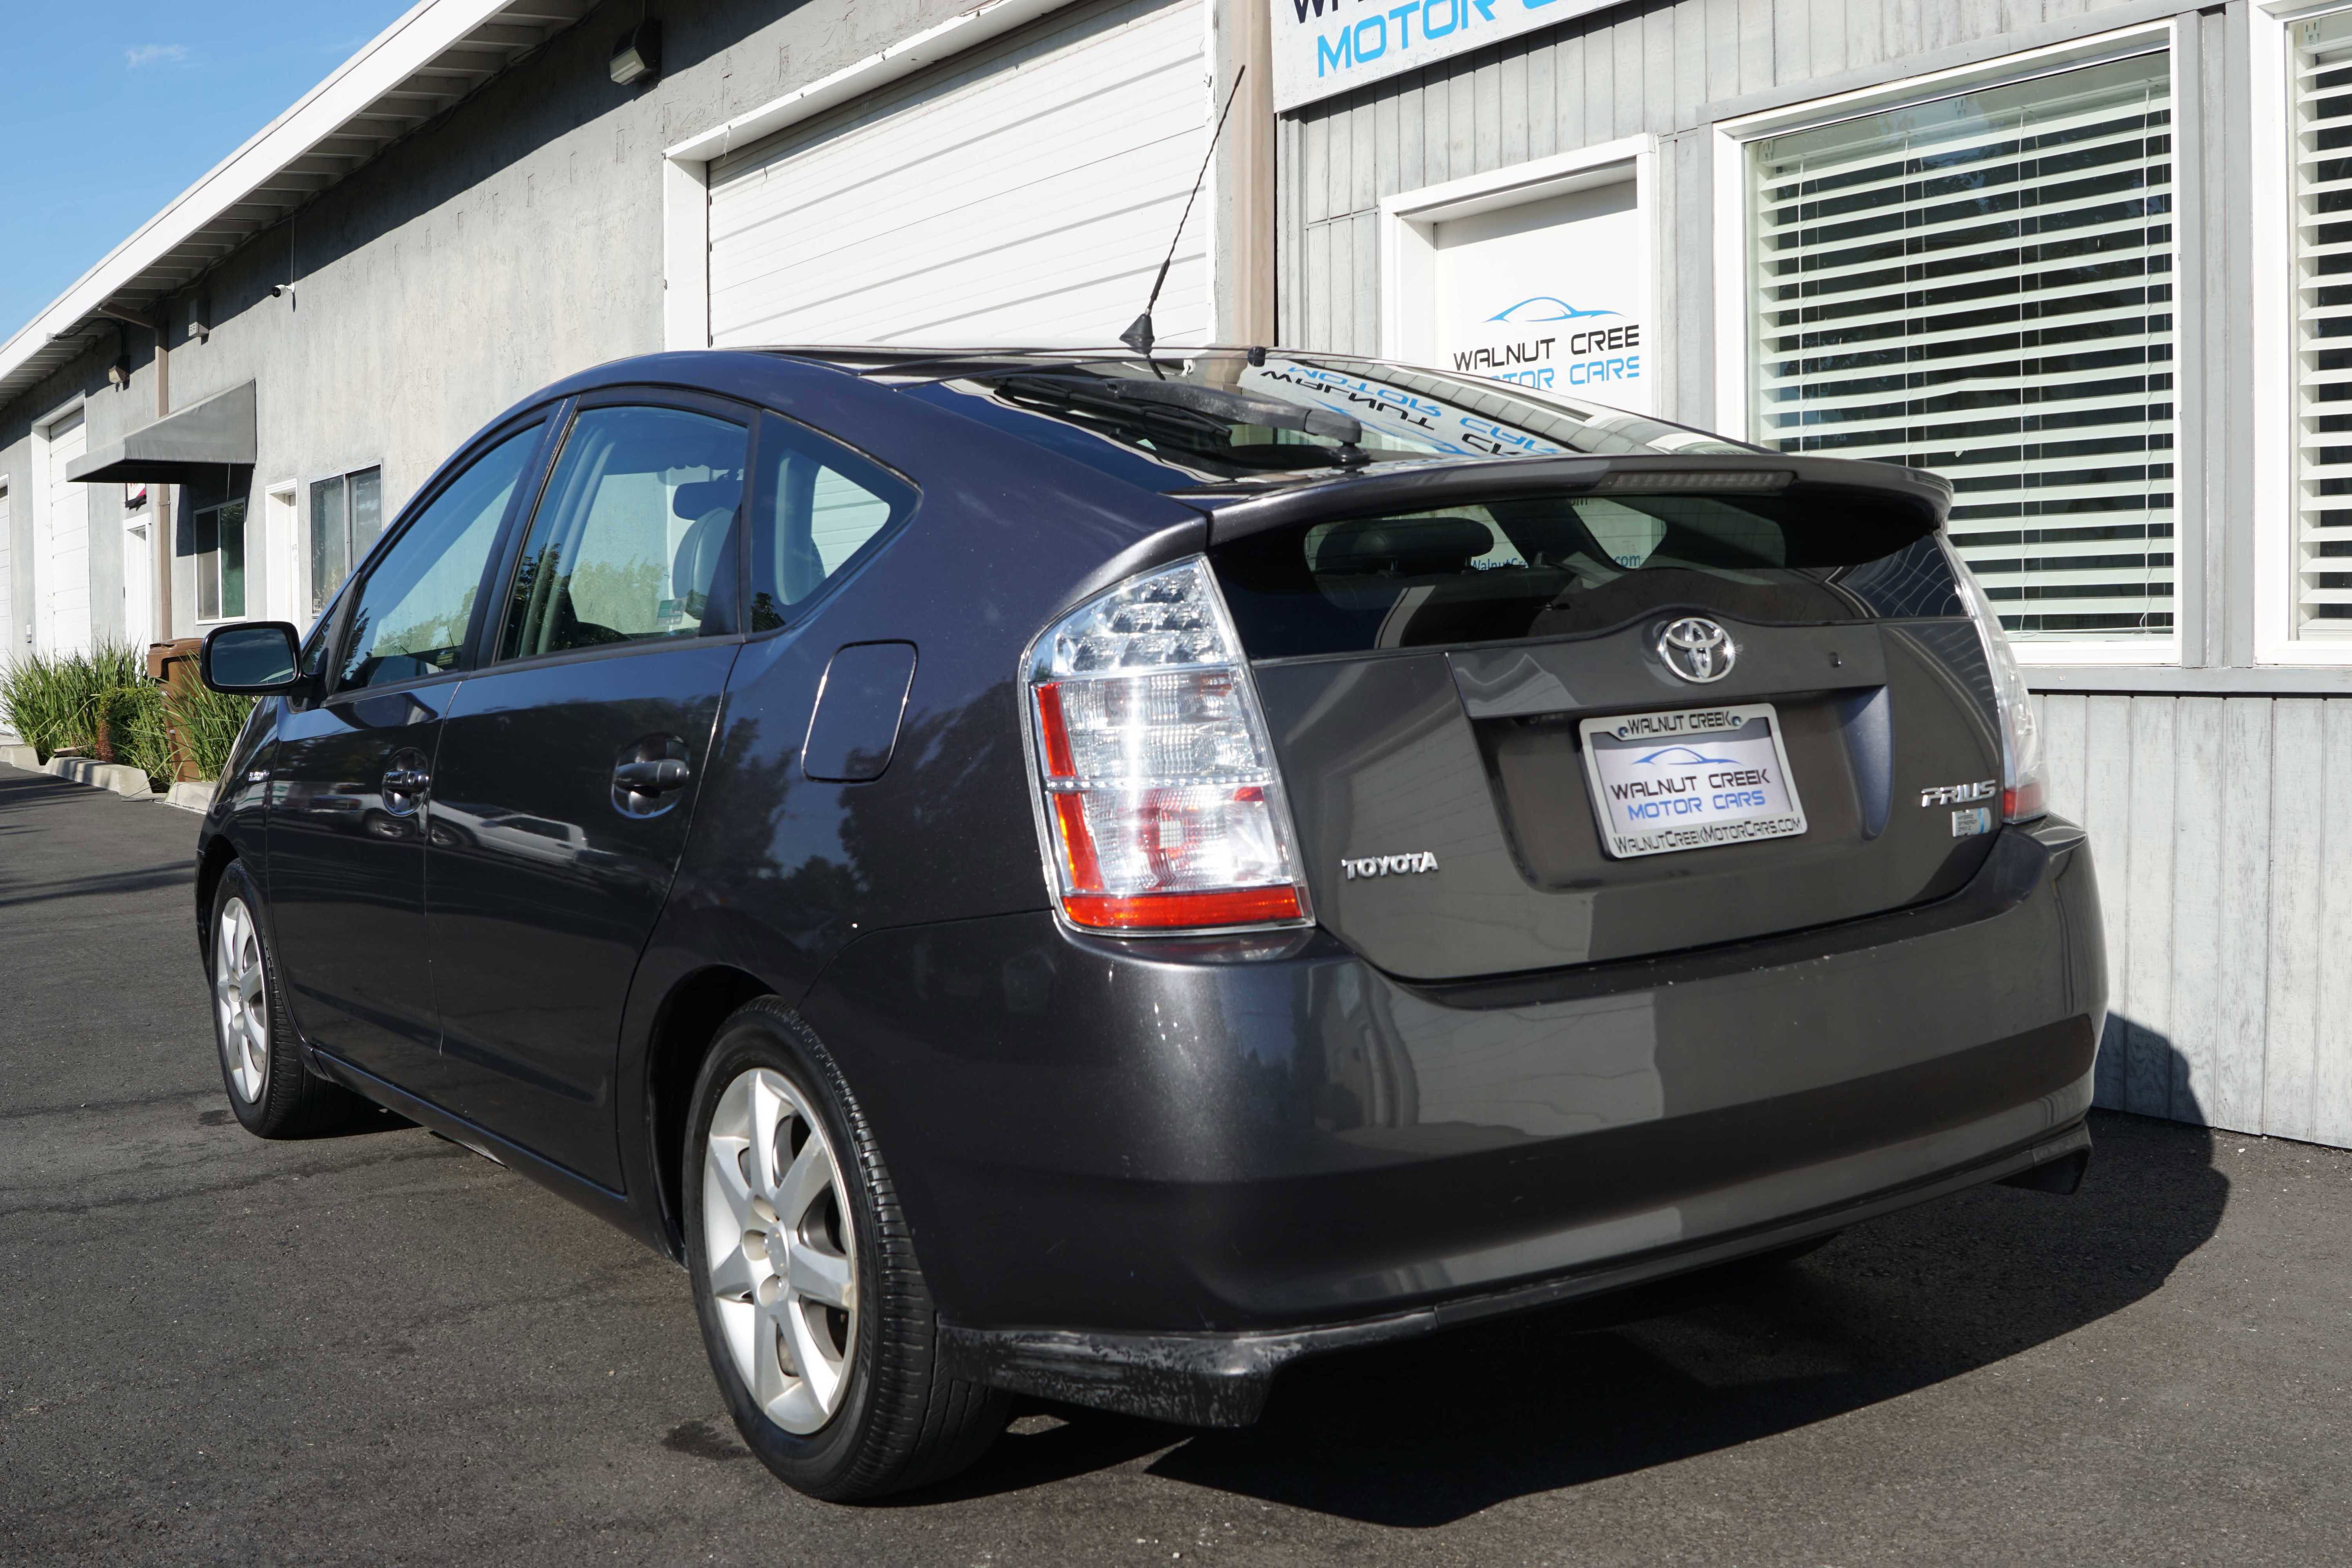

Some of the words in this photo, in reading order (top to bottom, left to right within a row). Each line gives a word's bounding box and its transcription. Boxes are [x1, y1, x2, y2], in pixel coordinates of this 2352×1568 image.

[1317, 0, 1496, 78] MOTOR
[1453, 338, 1555, 371] WALNUT
[1571, 324, 1639, 355] CREE
[1490, 368, 1555, 390] TOR
[1570, 356, 1639, 385] CARS
[1628, 715, 1684, 735] WALNUT
[1689, 711, 1732, 728] CREEK
[1610, 776, 1697, 800] WALNUT
[1709, 769, 1771, 789] CREEK
[1921, 779, 1996, 807] PRIUS
[1627, 796, 1702, 820] MOTOR
[1713, 790, 1766, 810] CARS
[1341, 851, 1439, 880] TOYOTA
